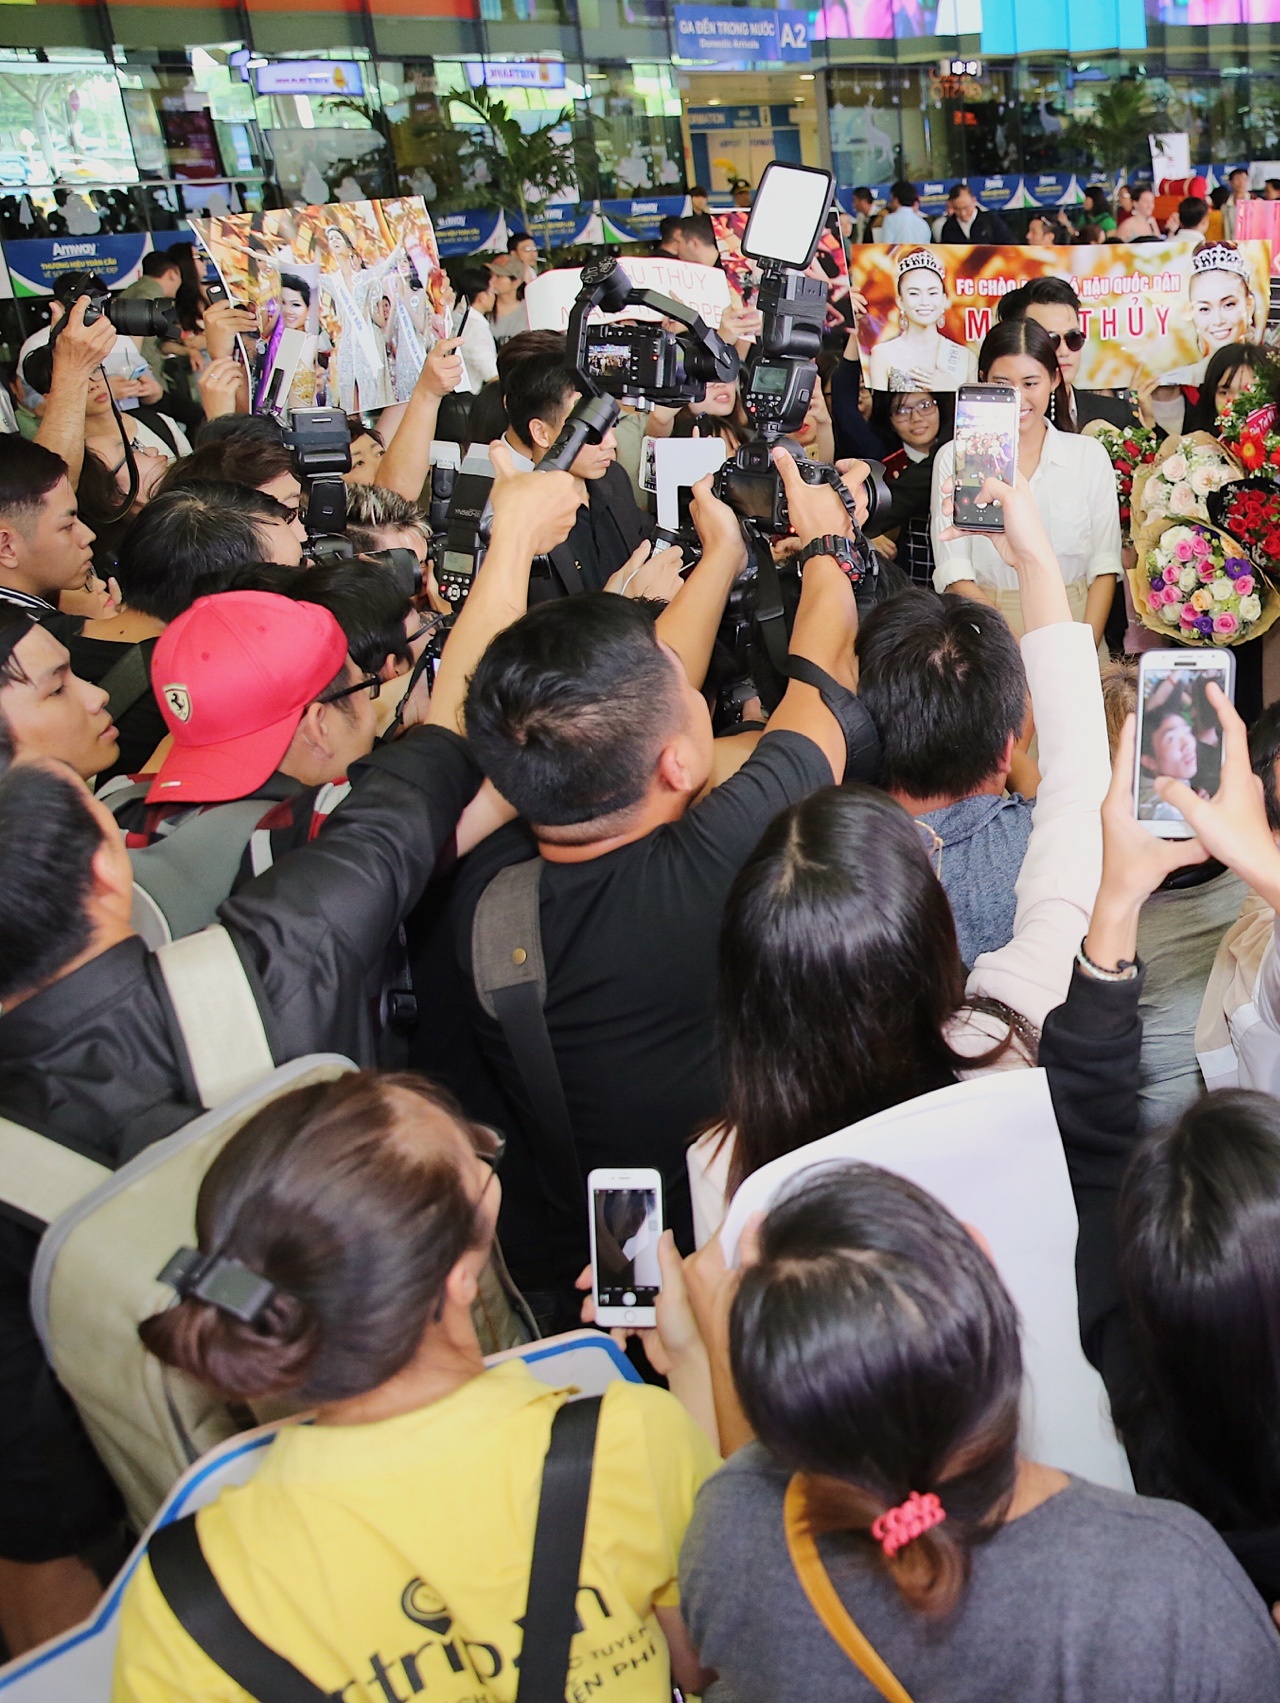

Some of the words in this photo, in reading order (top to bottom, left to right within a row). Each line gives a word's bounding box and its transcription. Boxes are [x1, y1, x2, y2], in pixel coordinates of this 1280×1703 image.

[679, 20, 695, 34] GA
[696, 17, 716, 35] ĐẾN
[717, 21, 749, 35] TRONG
[749, 20, 775, 36] NƯỚC
[781, 23, 807, 48] A2
[53, 242, 96, 258] Amway
[652, 264, 706, 291] THỦY
[956, 278, 975, 296] FC
[978, 276, 1015, 296] CHÀO
[1083, 275, 1111, 300] HẬU
[1112, 270, 1150, 295] QUỐC
[1151, 272, 1181, 294] DÂN
[1078, 297, 1171, 340] THỦY
